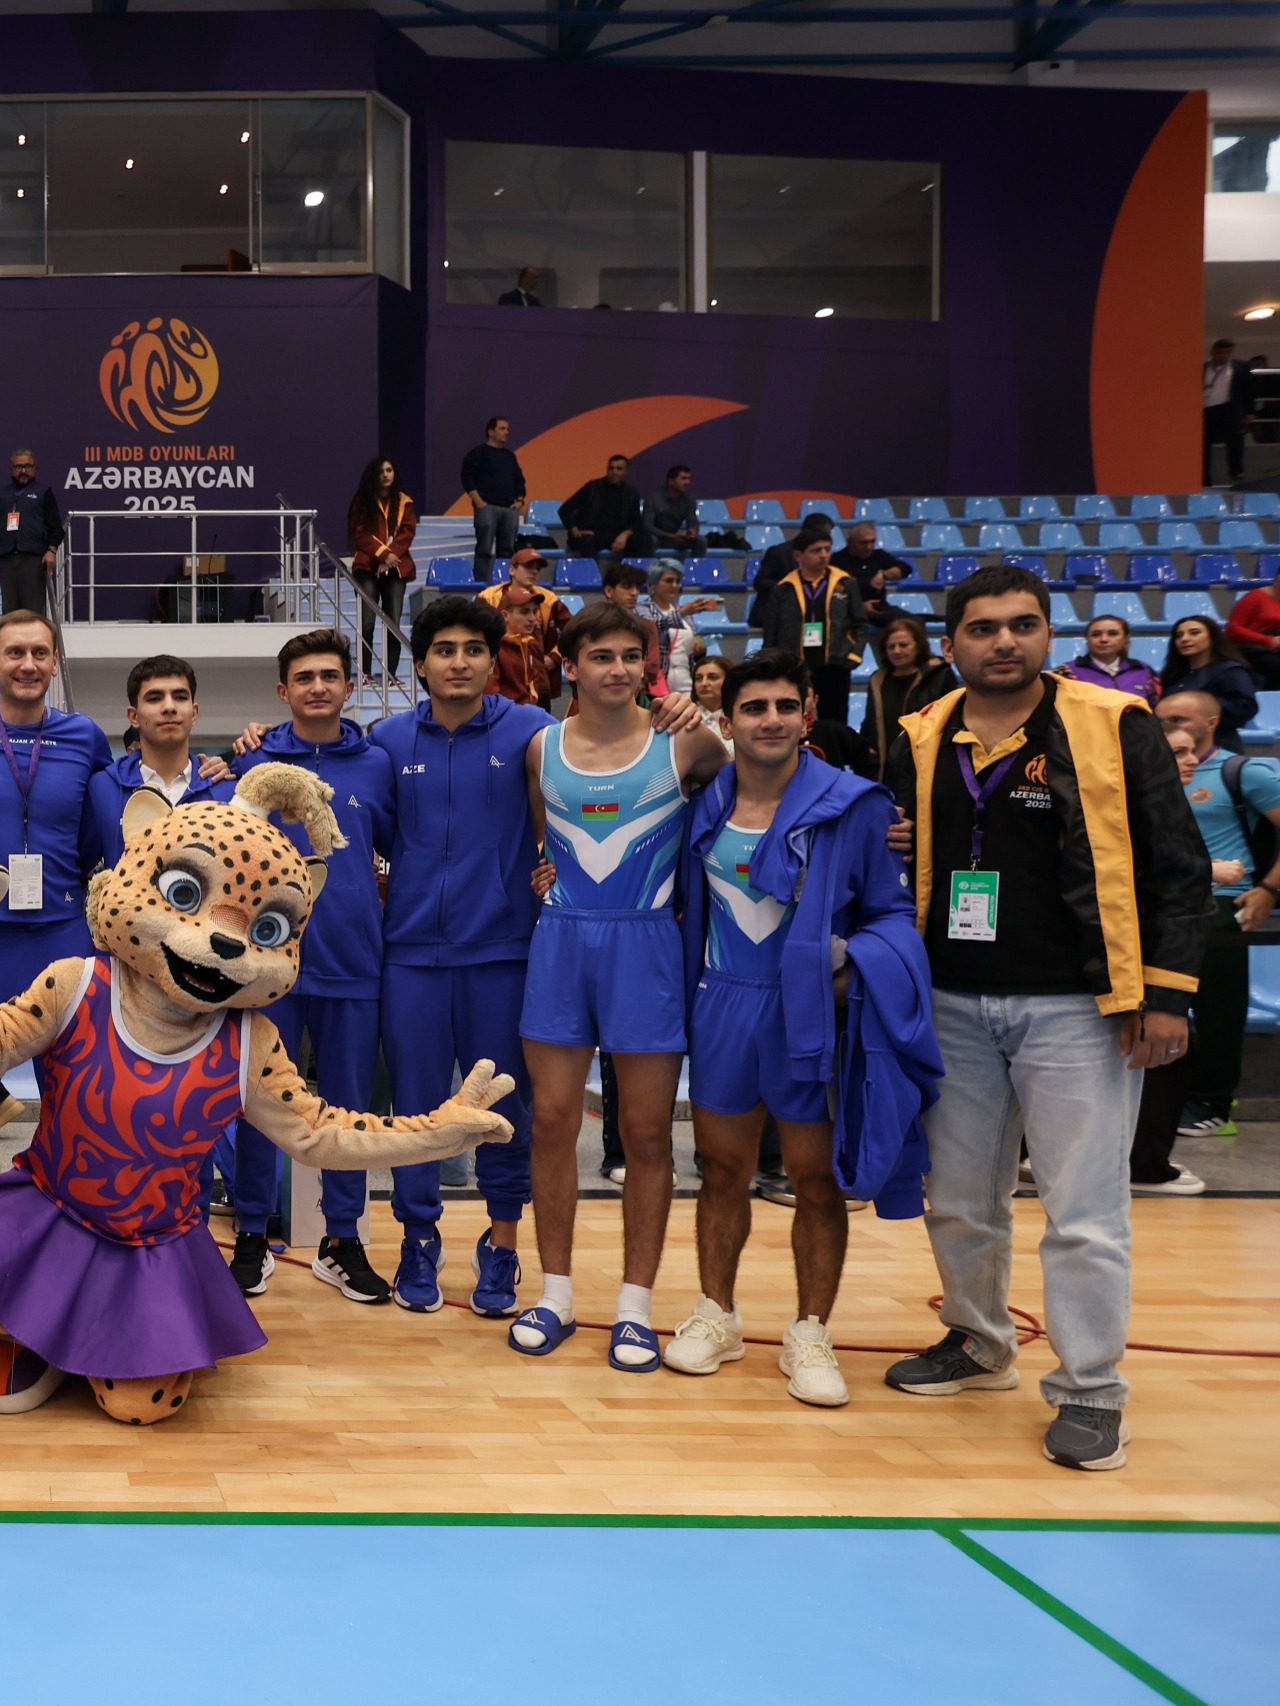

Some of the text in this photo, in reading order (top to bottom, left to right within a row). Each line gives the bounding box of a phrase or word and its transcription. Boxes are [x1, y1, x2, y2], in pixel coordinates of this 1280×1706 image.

[84, 445, 236, 462] III MDB OYUNLARI
[64, 465, 255, 490] AZƏRBAYCAN
[124, 495, 197, 519] 2025
[402, 763, 426, 775] AZE
[587, 784, 615, 792] TURN
[1009, 790, 1051, 801] AZERBA
[1024, 799, 1052, 809] 2025
